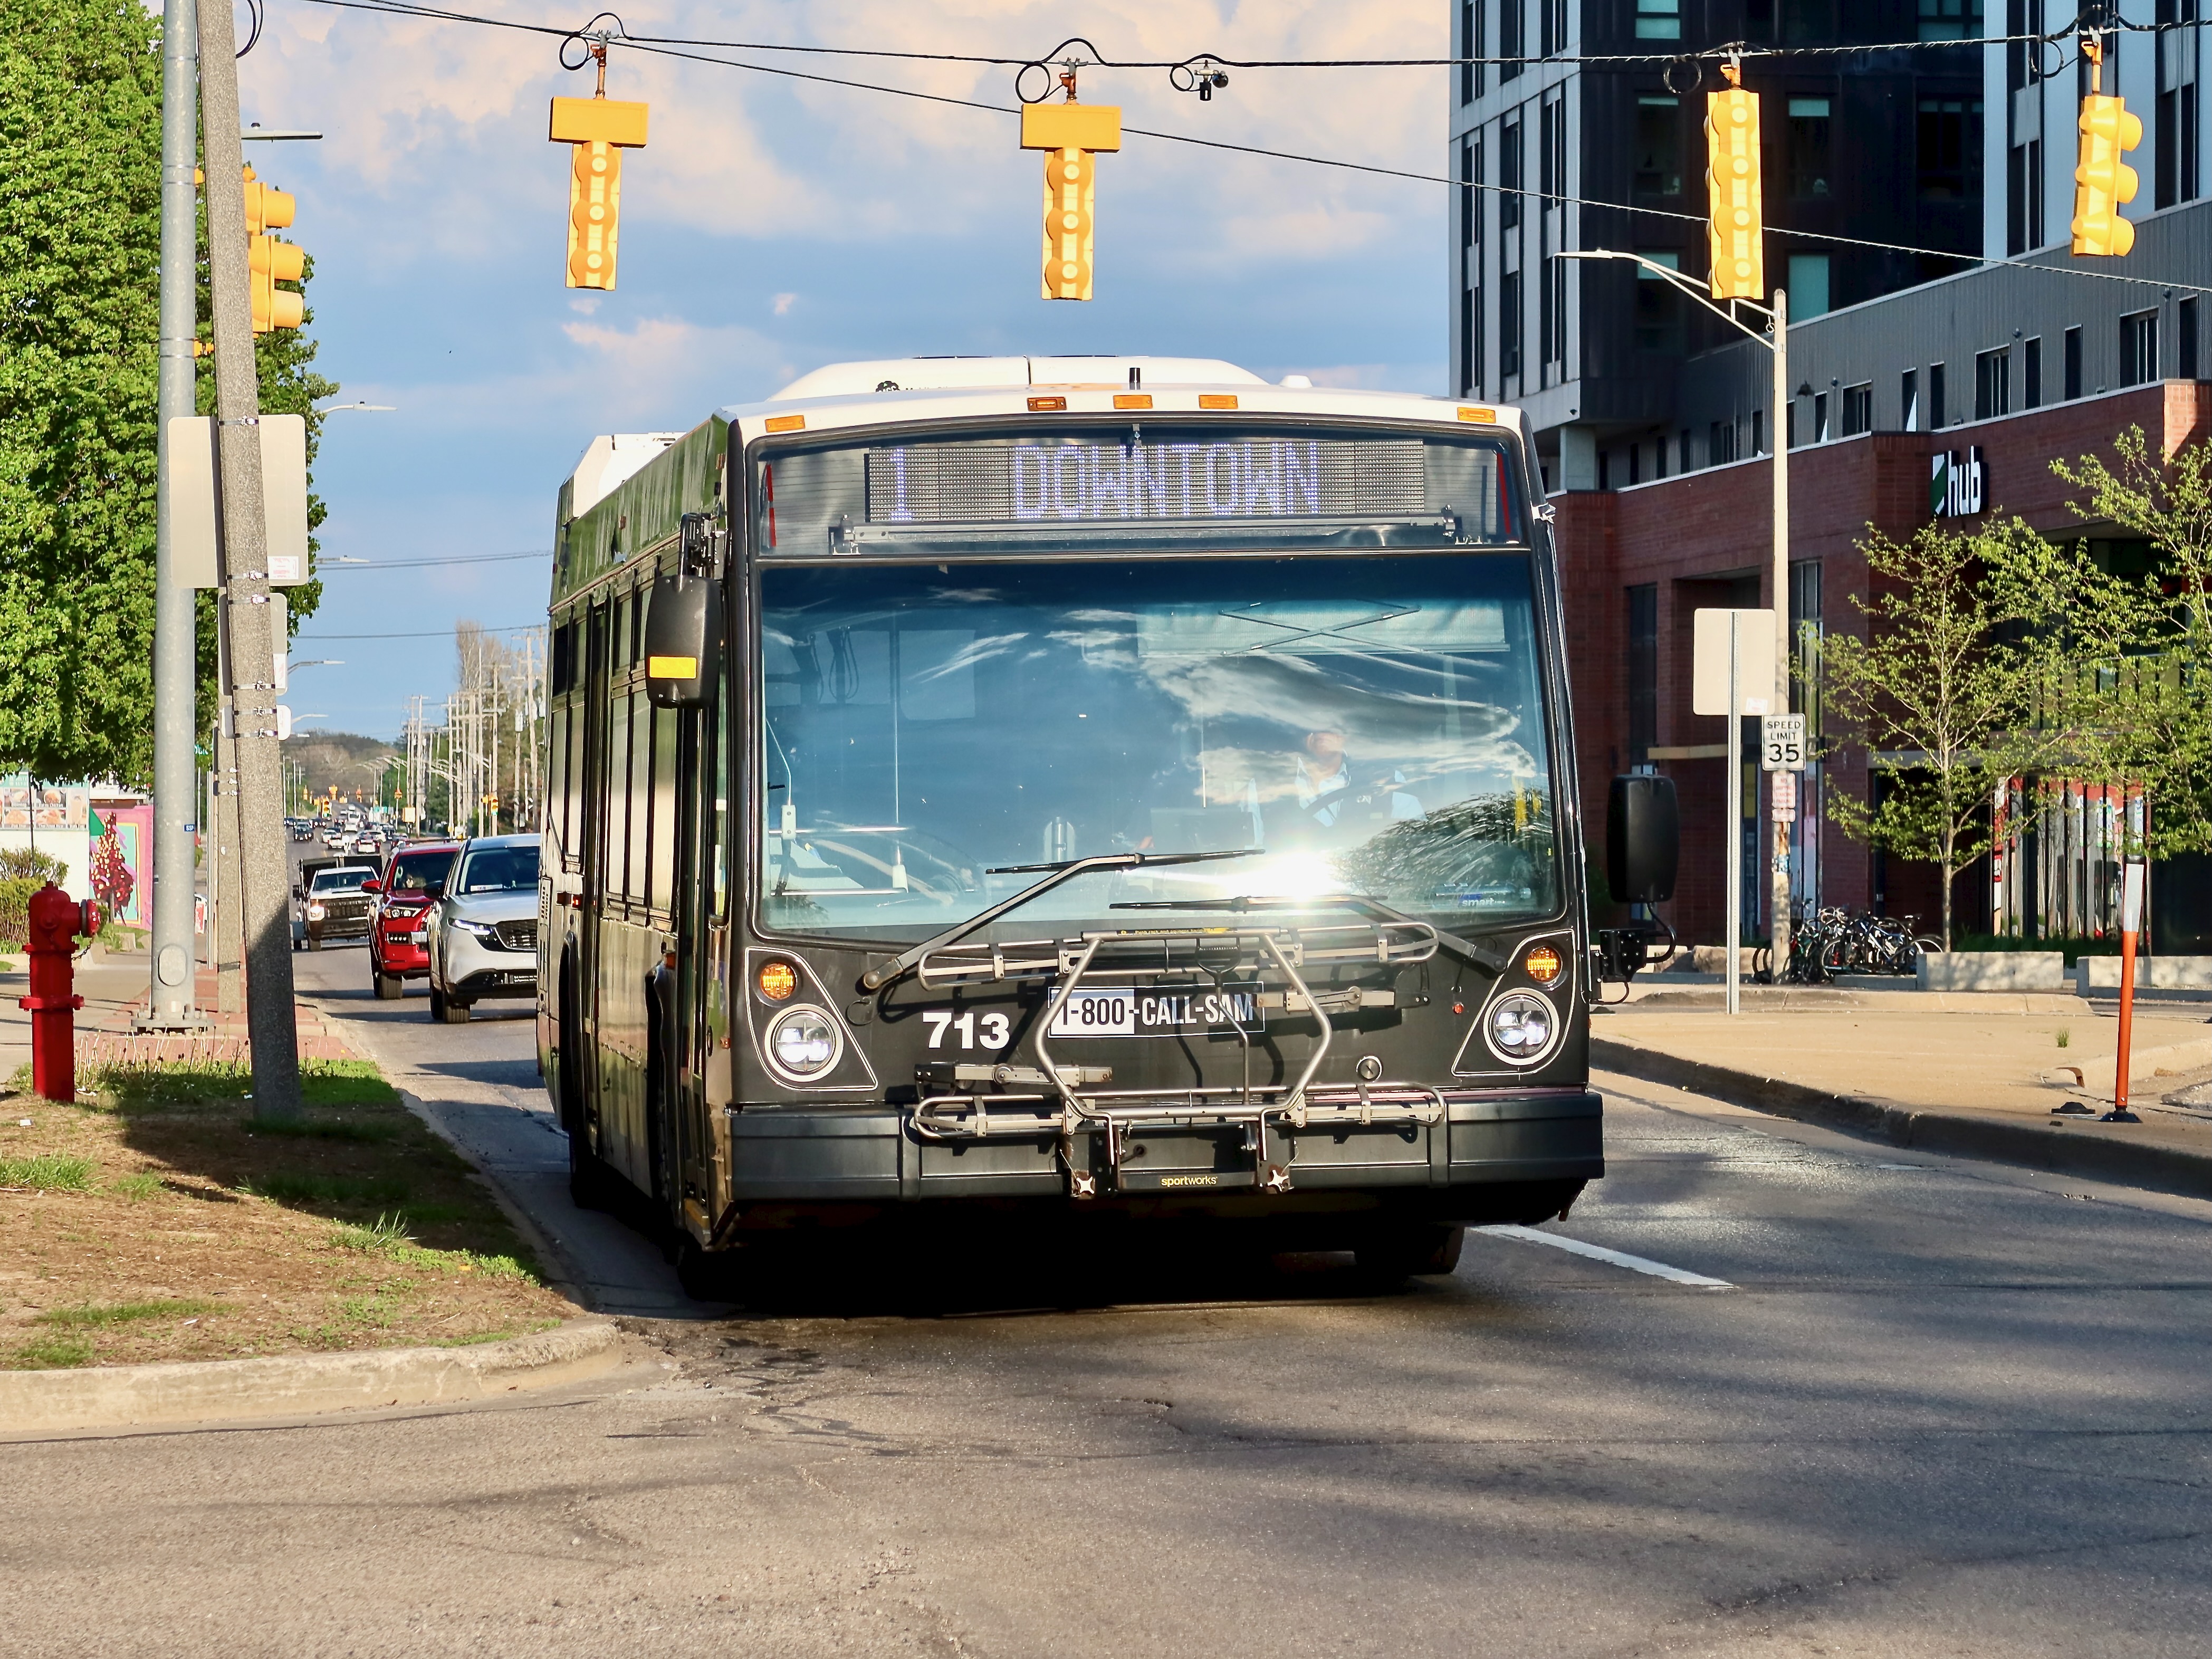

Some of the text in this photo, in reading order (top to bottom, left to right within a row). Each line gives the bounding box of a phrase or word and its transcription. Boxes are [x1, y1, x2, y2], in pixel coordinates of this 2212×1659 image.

[889, 442, 1319, 521] 1 DOWNTOWN
[1948, 445, 1981, 517] hub
[1770, 732, 1796, 741] LIMIT
[1769, 743, 1799, 762] 35
[1462, 898, 1494, 907] smart
[1062, 993, 1253, 1026] 1-800-CALL-SAM
[923, 1012, 1010, 1050] 713
[1161, 1175, 1217, 1187] sportworks
